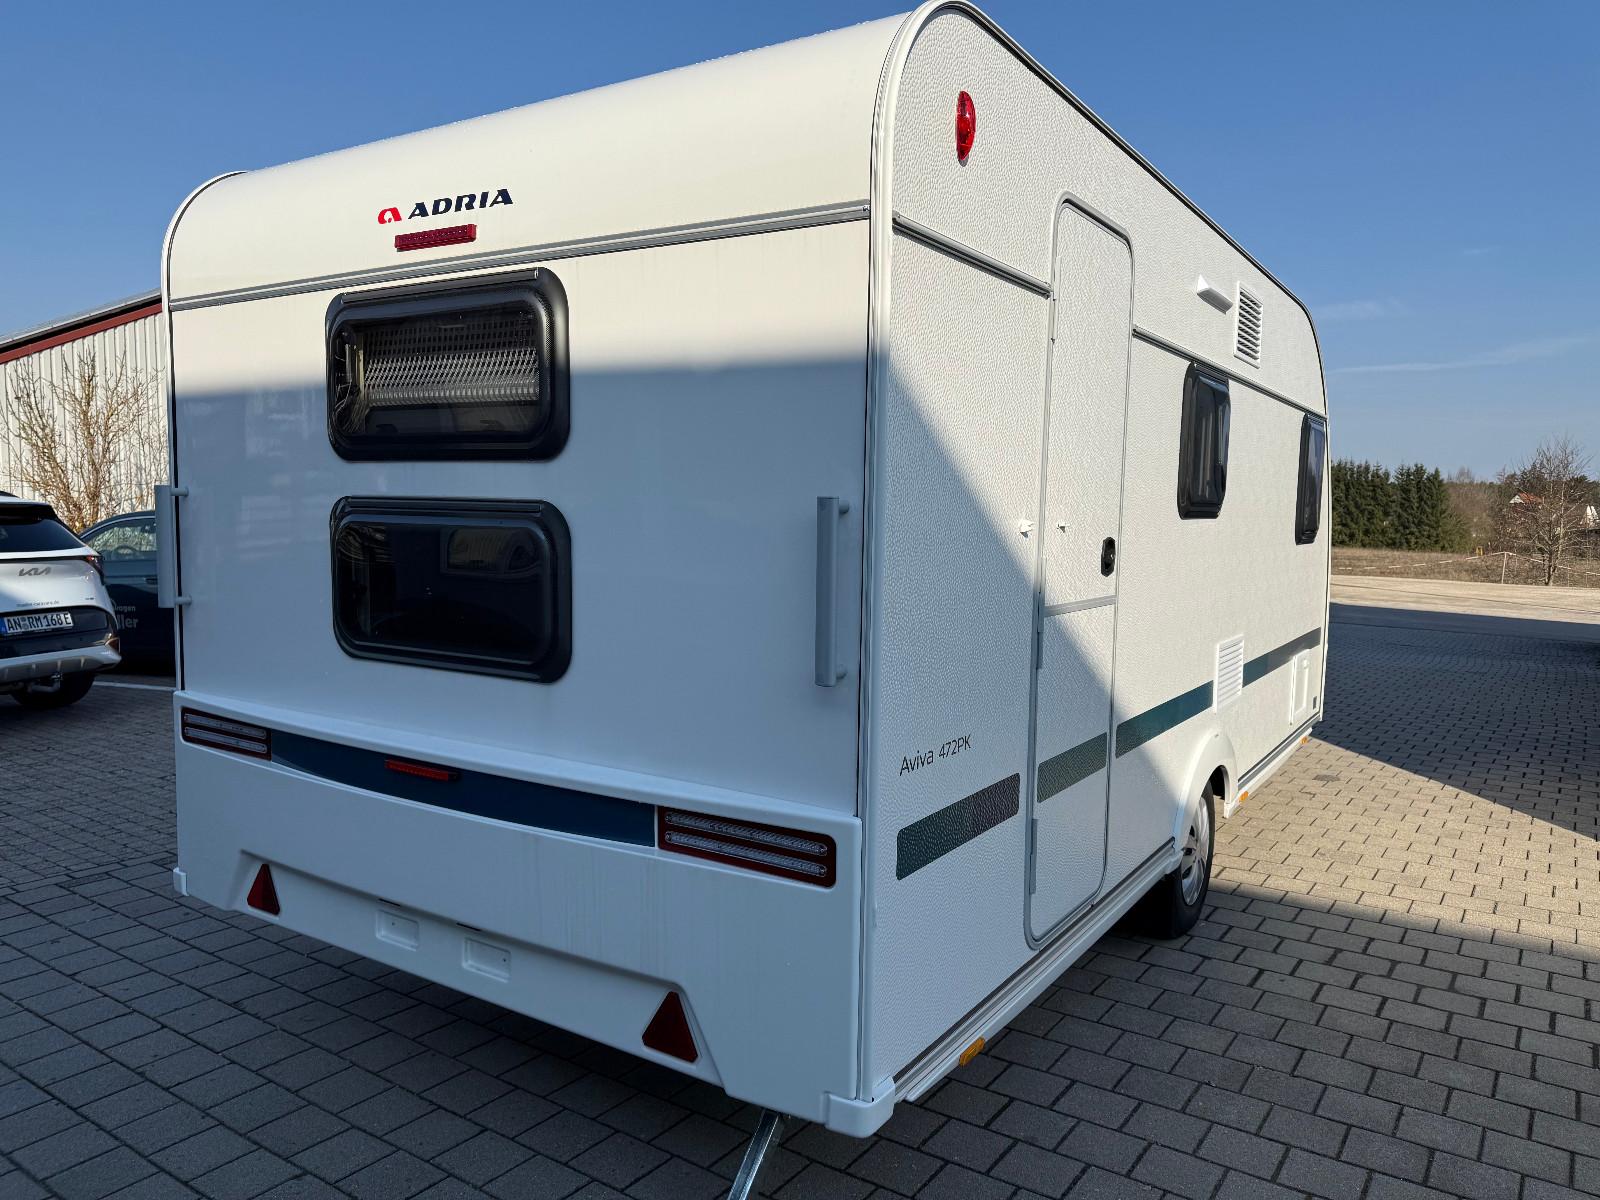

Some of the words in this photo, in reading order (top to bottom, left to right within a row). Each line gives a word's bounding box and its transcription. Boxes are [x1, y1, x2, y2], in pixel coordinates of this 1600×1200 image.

[407, 188, 514, 220] ADRIA
[6, 615, 22, 631] AN
[899, 749, 934, 777] Aviva
[938, 733, 972, 759] 472PK
